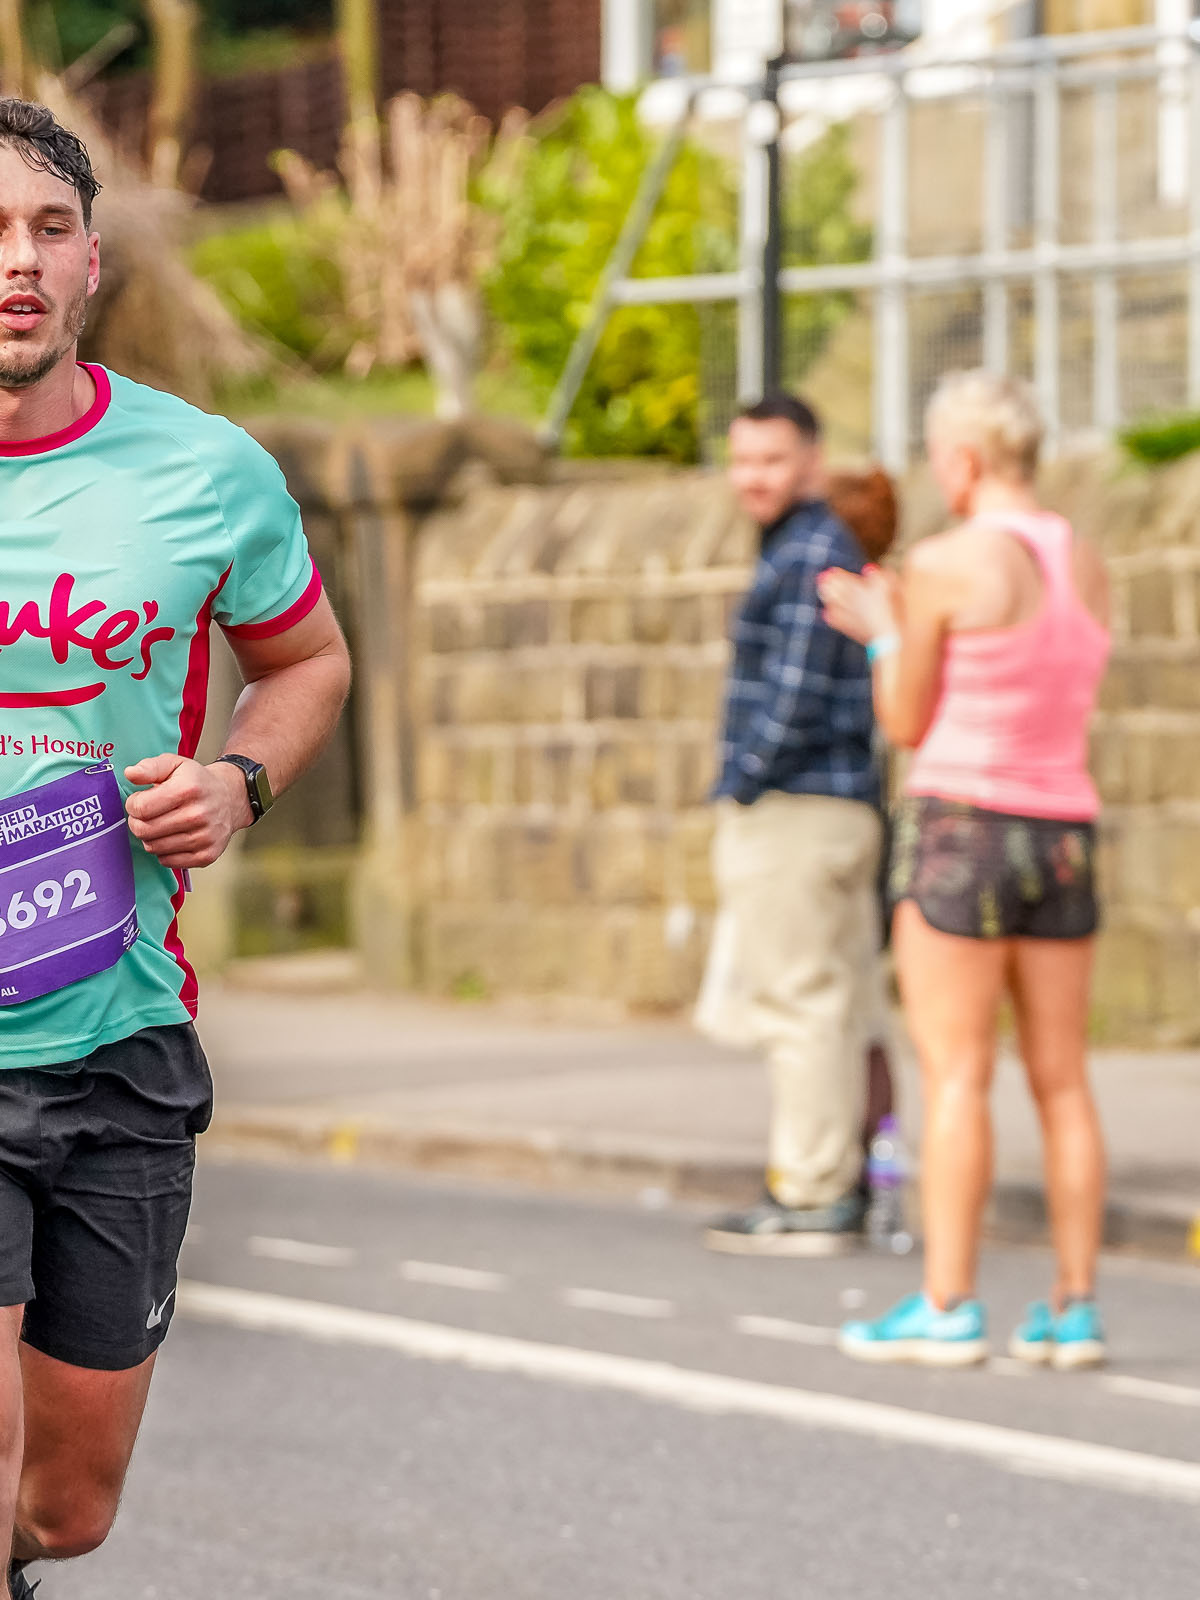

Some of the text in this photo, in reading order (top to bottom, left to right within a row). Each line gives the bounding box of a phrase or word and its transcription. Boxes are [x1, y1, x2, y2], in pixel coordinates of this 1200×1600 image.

[31, 734, 115, 759] Hospice
[7, 797, 99, 843] MARATHON
[61, 812, 105, 840] 2022
[1, 986, 19, 997] ALL
